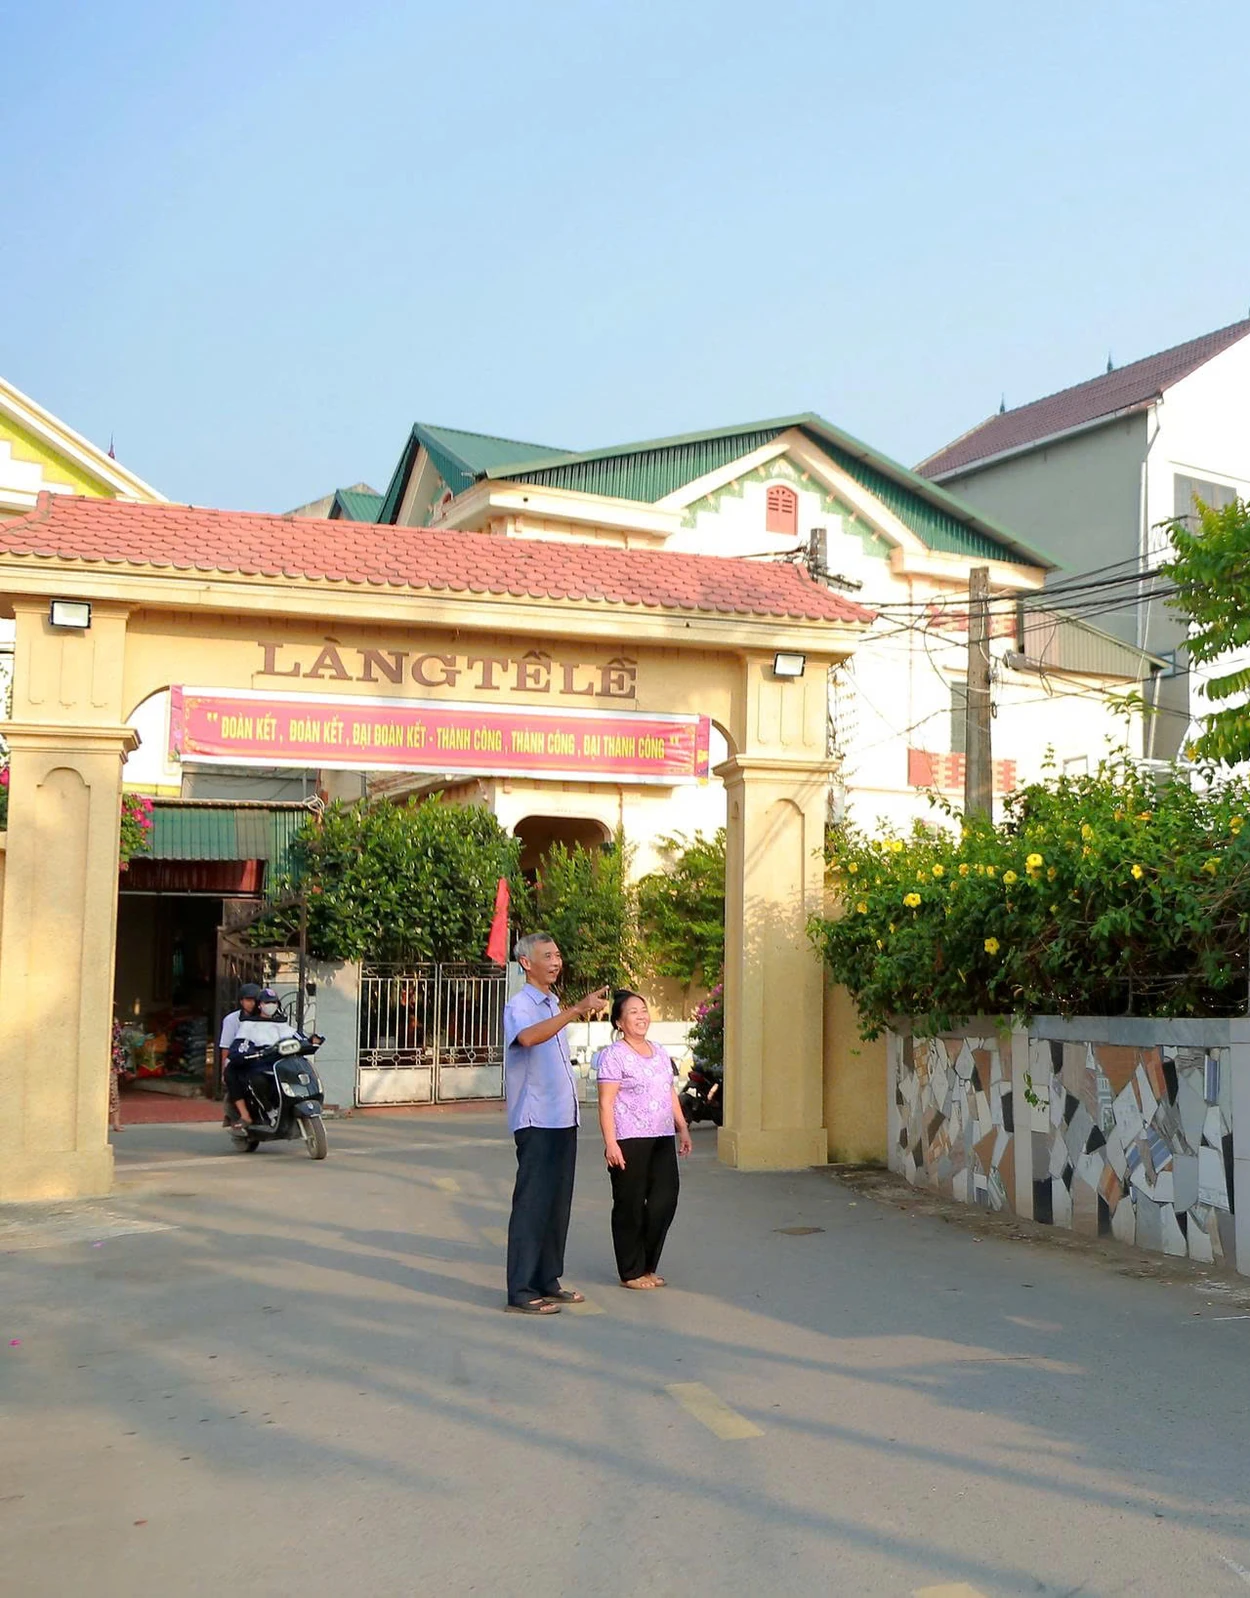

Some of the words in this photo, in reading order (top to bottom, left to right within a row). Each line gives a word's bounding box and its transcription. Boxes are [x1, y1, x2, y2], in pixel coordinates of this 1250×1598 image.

[289, 715, 320, 743] ĐOÀN
[352, 722, 372, 750] ĐẠI
[374, 719, 403, 748] ĐOÀN
[406, 719, 427, 748] KẾT
[437, 723, 471, 751] THÀNH
[511, 727, 544, 754] THÀNH
[583, 734, 600, 761] ĐẠI
[603, 733, 635, 758] THÀNH
